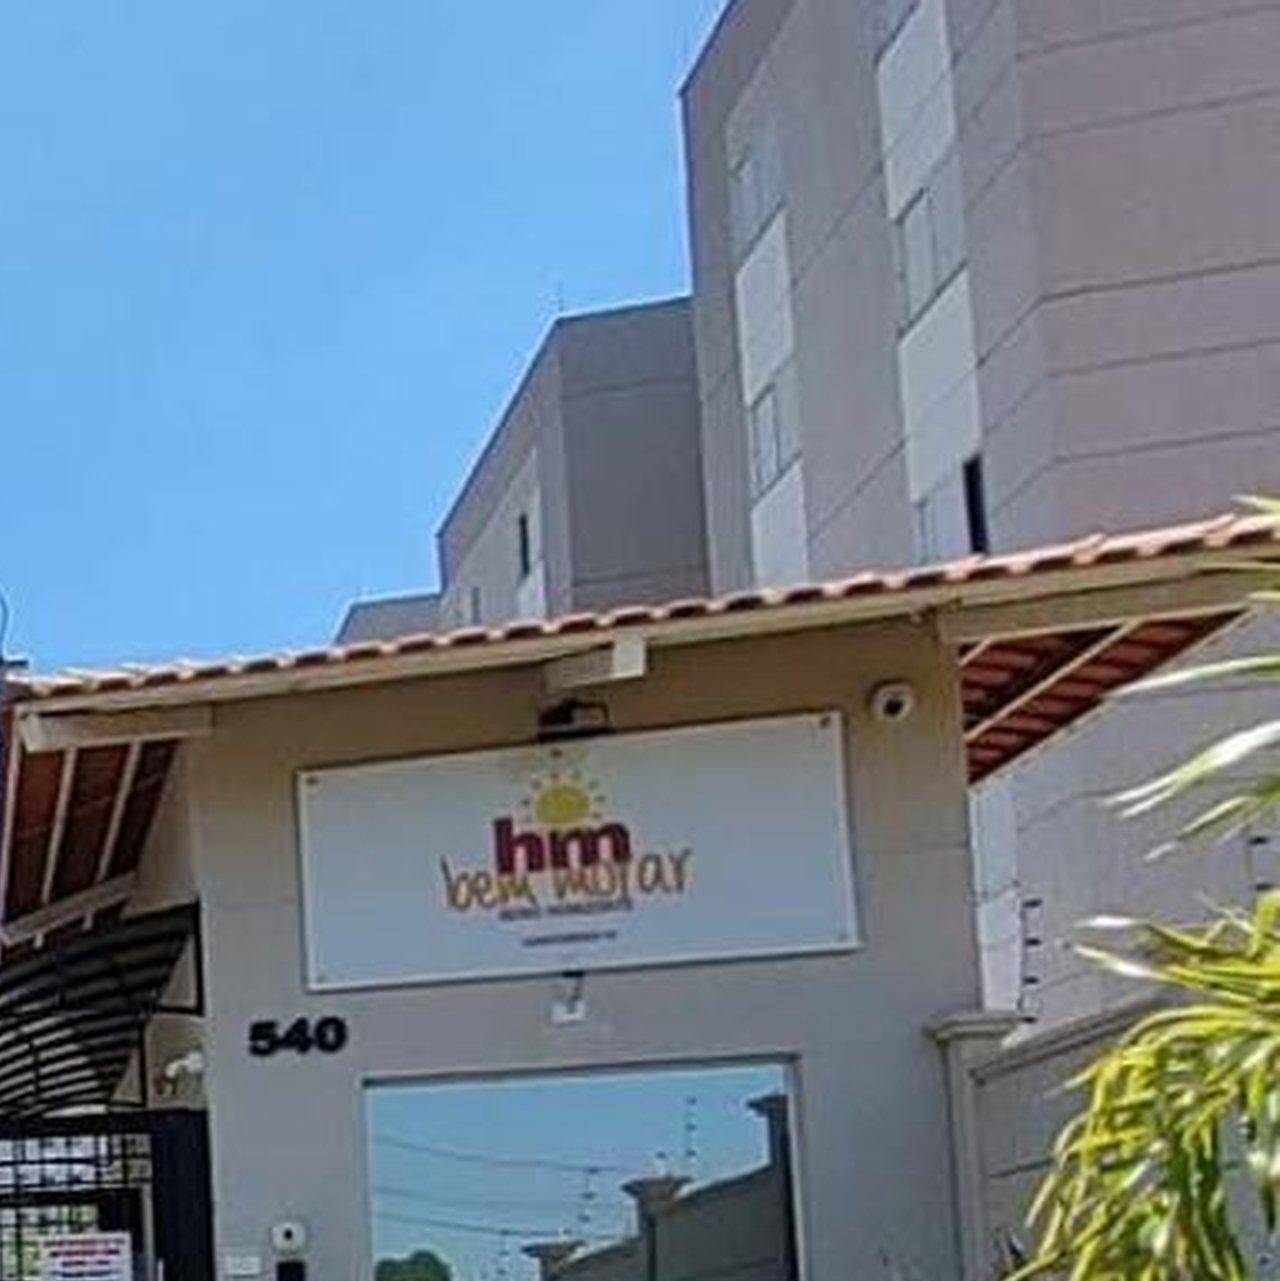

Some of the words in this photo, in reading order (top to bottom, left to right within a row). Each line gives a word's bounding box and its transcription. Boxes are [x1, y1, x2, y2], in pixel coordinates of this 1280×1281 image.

[493, 816, 631, 876] hm
[440, 853, 538, 910] bem
[552, 846, 694, 902] morar
[248, 1016, 348, 1056] 540
